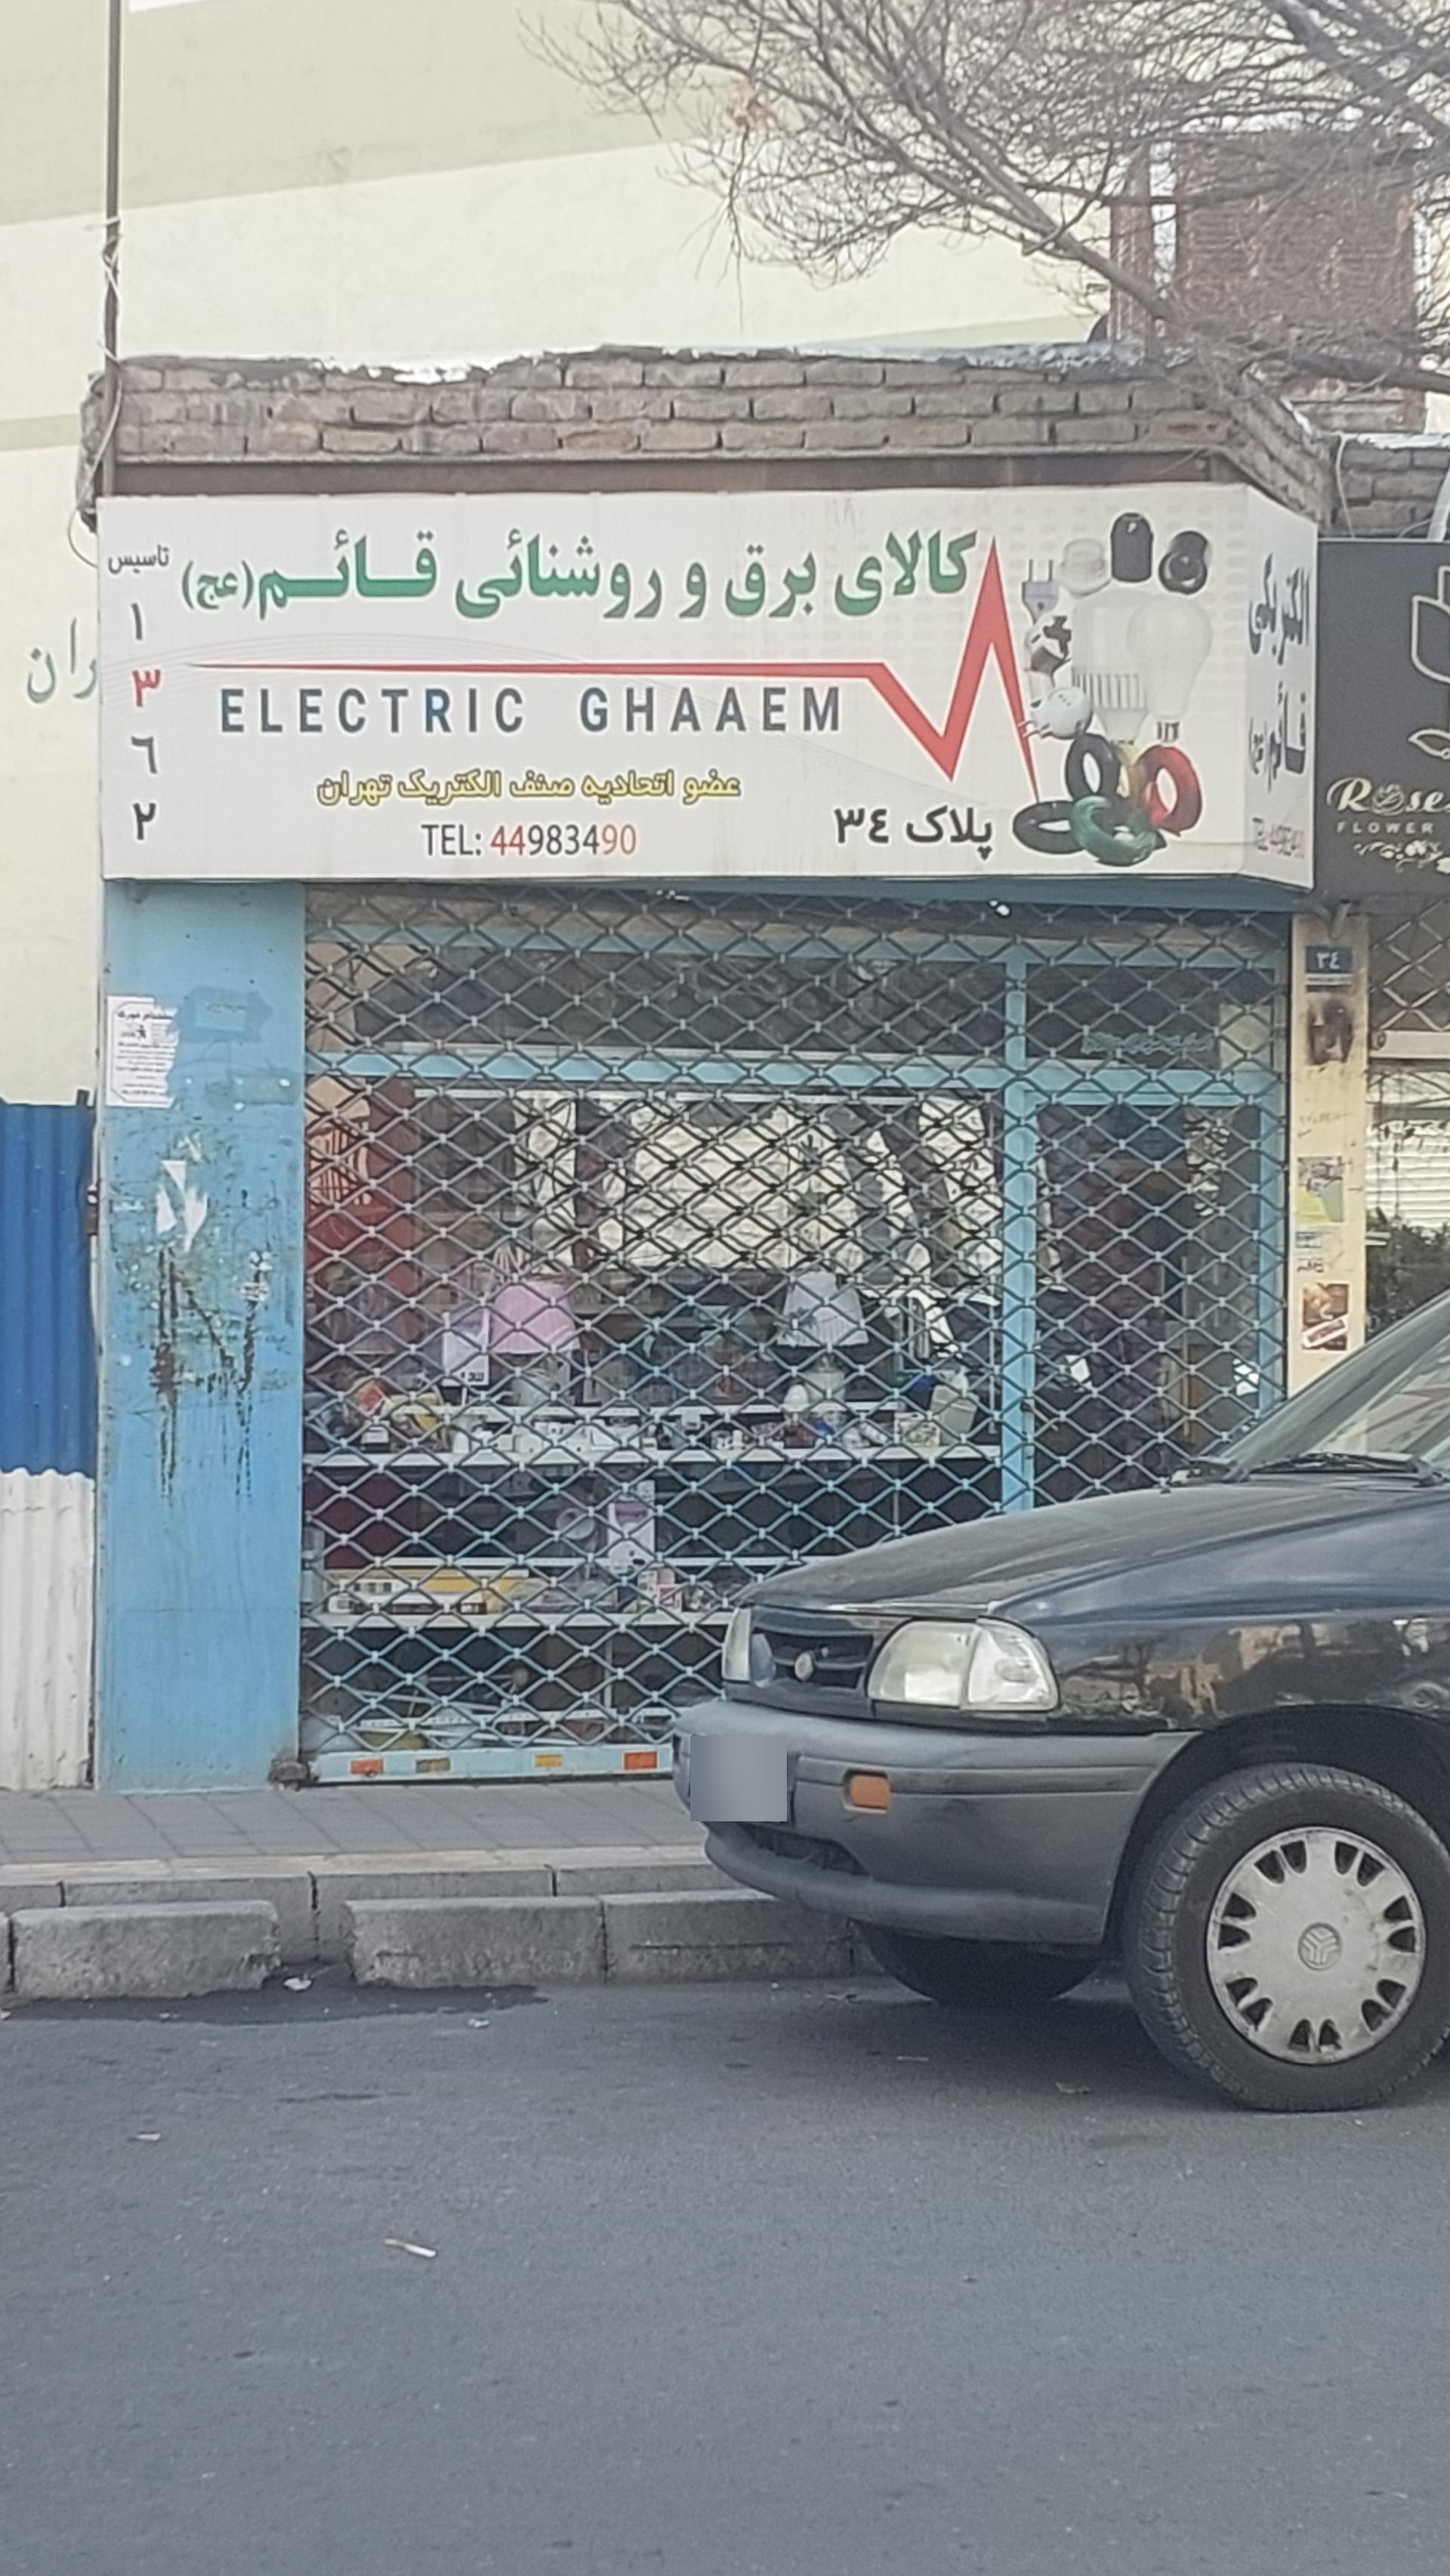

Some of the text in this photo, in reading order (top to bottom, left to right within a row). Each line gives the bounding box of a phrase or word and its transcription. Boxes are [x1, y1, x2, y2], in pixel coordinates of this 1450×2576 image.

[108, 544, 170, 575] تاسیس
[455, 528, 662, 619] روشنائی
[725, 544, 816, 619] برق
[834, 530, 977, 617] کالای
[679, 561, 708, 619] و
[221, 686, 840, 734] ELECTRIC GHAAEM
[316, 768, 742, 807] عضو اتحادیه صنف الکتریک تهران
[420, 823, 637, 857] TEL: 44983490
[905, 805, 993, 861] پلاک
[1337, 821, 1434, 835] FLOWER
